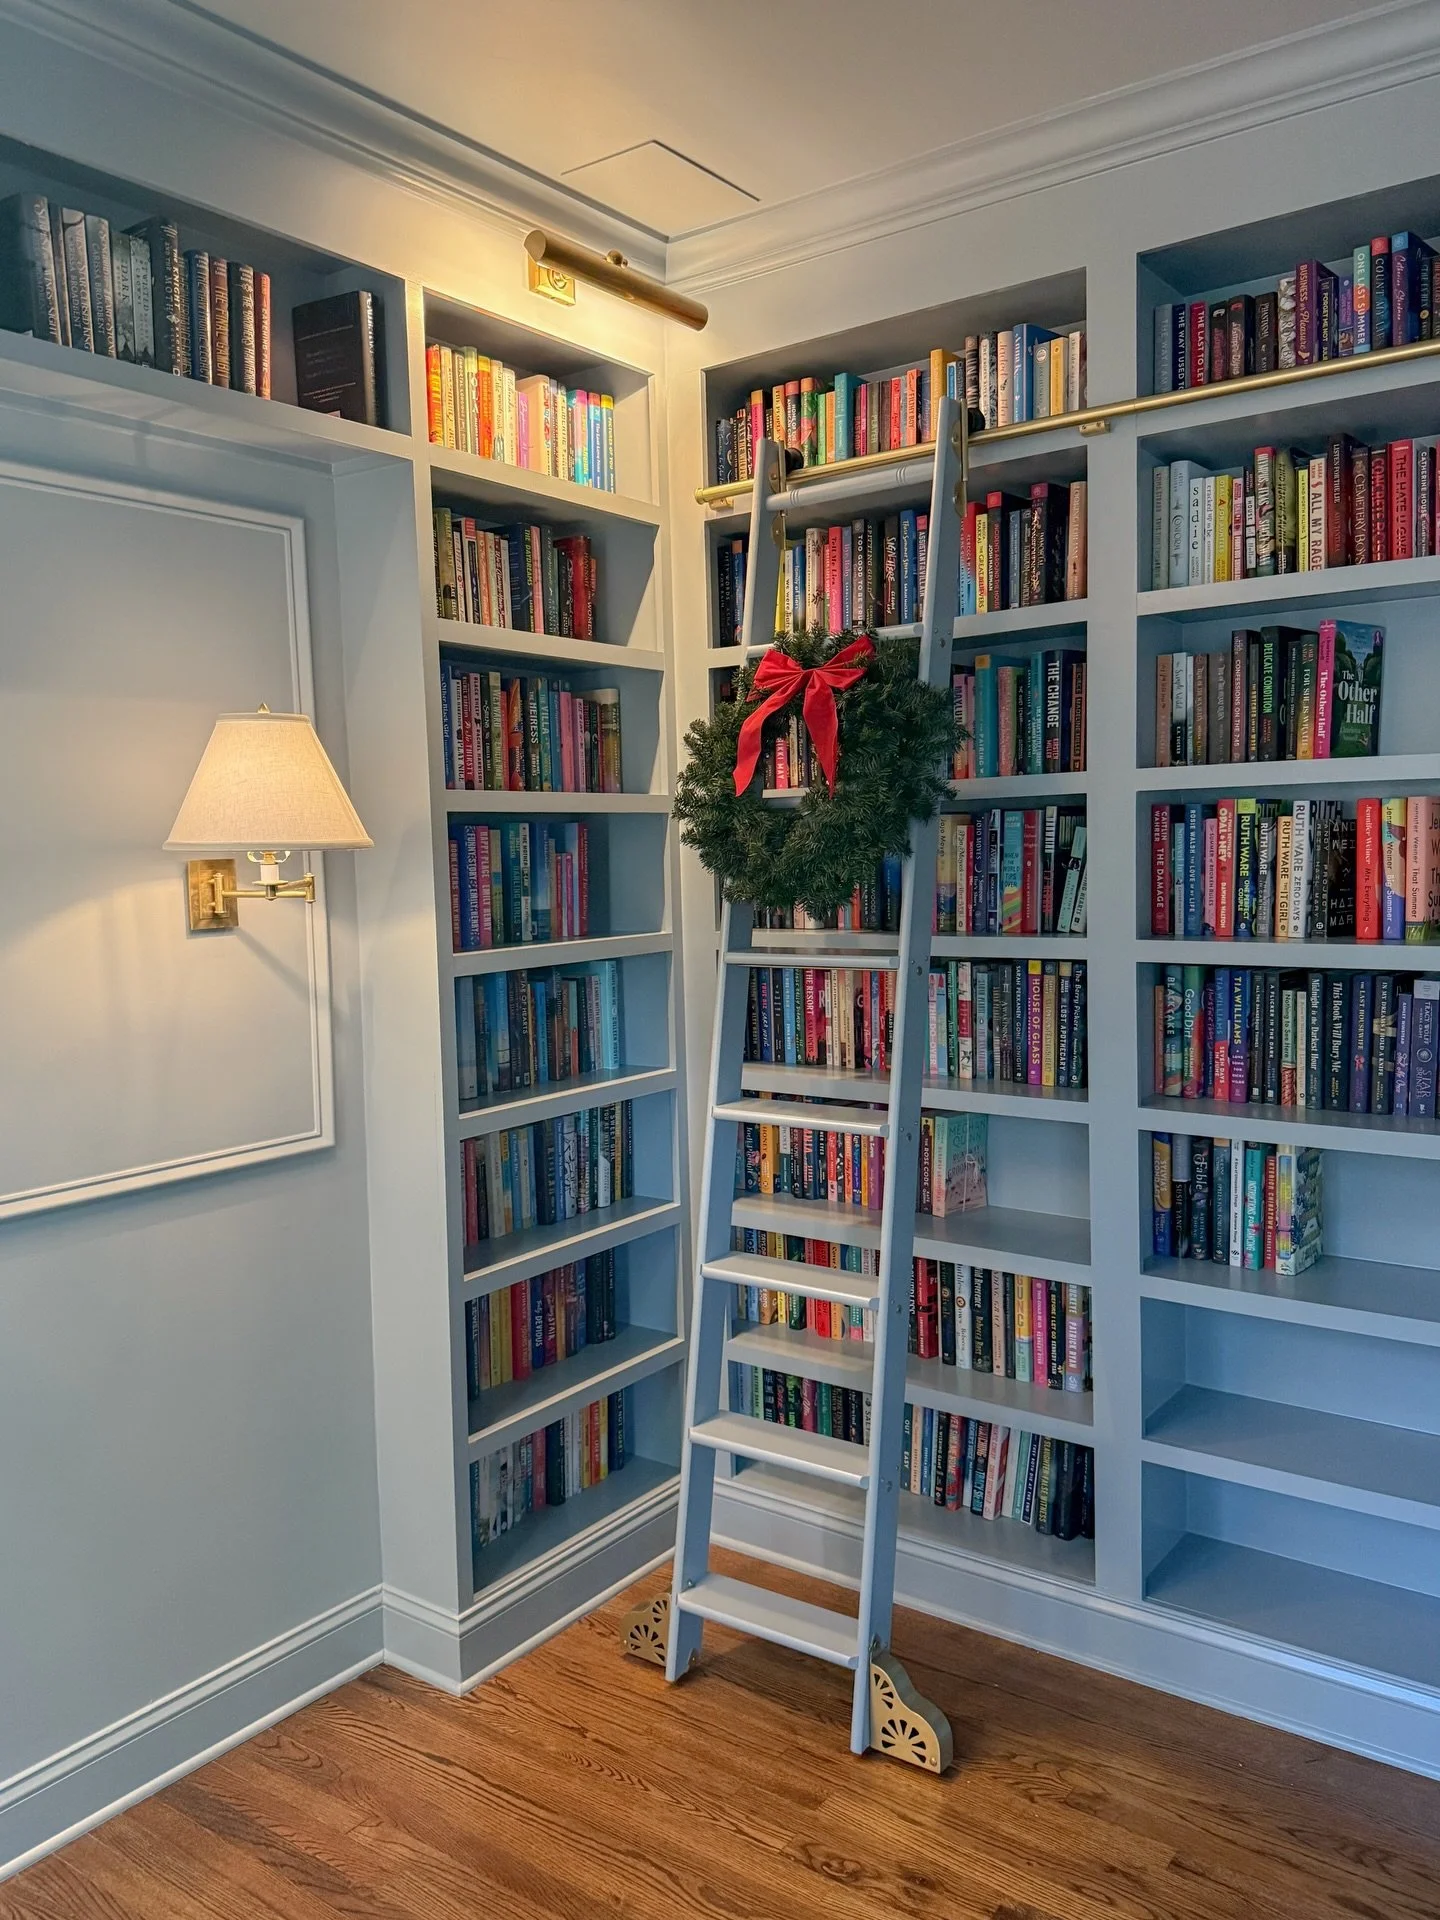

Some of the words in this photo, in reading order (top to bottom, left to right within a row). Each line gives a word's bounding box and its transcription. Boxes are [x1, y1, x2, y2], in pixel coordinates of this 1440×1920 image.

[92, 243, 101, 278] CARISSA
[1357, 252, 1365, 273] ONE
[121, 265, 130, 301] DARK
[164, 275, 173, 312] MOTH
[215, 285, 228, 303] THE
[1357, 277, 1365, 301] LAST
[70, 275, 81, 328] BROADBENT
[94, 281, 105, 335] BROADBENT
[215, 309, 229, 338] FINAL
[1197, 310, 1205, 330] THE
[1357, 302, 1365, 345] SUMMER
[1197, 330, 1205, 352] LAST
[216, 342, 230, 378] GAMBIT
[1197, 353, 1204, 366] TO
[1396, 455, 1407, 479] THE
[1311, 492, 1322, 513] ALL
[1354, 474, 1366, 532] CEMETERY
[1396, 481, 1407, 512] HATE
[1191, 485, 1201, 551] sadie
[1311, 518, 1322, 535] MY
[1396, 514, 1407, 523] U
[1354, 533, 1366, 564] BOYS
[1396, 526, 1407, 555] GIVE
[831, 554, 838, 568] Me
[1311, 539, 1322, 571] RAGE
[857, 580, 864, 592] TO
[857, 592, 863, 603] BE
[1047, 660, 1060, 681] THE
[1263, 643, 1274, 674] DELICATE
[1319, 670, 1328, 687] The
[1342, 669, 1355, 681] The
[1262, 676, 1273, 714] CONDITION
[1318, 688, 1328, 717] Other
[1338, 680, 1378, 703] Other
[1046, 684, 1060, 729] CHANGE
[1346, 700, 1377, 725] Half
[529, 702, 539, 744] HEIRESS
[540, 706, 549, 735] VILLA
[1317, 718, 1327, 738] Half
[465, 744, 474, 776] THIRSTY
[1240, 815, 1251, 848] RUTH
[1294, 804, 1306, 837] RUTH
[466, 833, 476, 856] FUNNY
[480, 831, 489, 855] HAPPY
[1259, 822, 1268, 848] RUTH
[1239, 849, 1249, 877] WARE
[1259, 849, 1268, 876] WARE
[1294, 839, 1303, 872] WARE
[468, 859, 477, 880] STORY
[481, 857, 490, 879] PLACE
[469, 888, 478, 908] EMILY
[482, 884, 490, 906] EMILY
[1156, 868, 1164, 908] DAMAGE
[1292, 901, 1300, 921] DAYS
[1363, 885, 1371, 922] Everything
[470, 910, 479, 932] HENRY
[483, 908, 492, 931] HENRY
[805, 969, 814, 984] THE
[1074, 970, 1083, 982] The
[1234, 976, 1242, 993] TIA
[520, 993, 527, 1005] OF
[806, 985, 814, 1017] RESORT
[1032, 978, 1040, 1013] HOUSE
[1073, 984, 1082, 1004] Berry
[1332, 981, 1343, 999] This
[1060, 1004, 1068, 1023] LOST
[1184, 988, 1195, 1018] Good
[1332, 999, 1343, 1020] Book
[1000, 1001, 1009, 1041] AWAKENING
[1032, 1016, 1040, 1030] OF
[1184, 1019, 1194, 1038] Dirt
[1234, 995, 1242, 1045] WILLIAMS
[1332, 1022, 1343, 1038] Will
[1032, 1032, 1041, 1065] GLASS
[1059, 1024, 1067, 1071] APOTHECARY
[1329, 1040, 1342, 1059] Bury
[1331, 1060, 1342, 1073] Me
[1421, 1070, 1432, 1098] STAR
[1194, 1160, 1208, 1190] Fable
[535, 1315, 543, 1347] DEVIOUS
[1068, 1320, 1078, 1350] PATRICK
[1068, 1351, 1078, 1369] RYAN
[1039, 1476, 1049, 1497] FALSE
[1039, 1497, 1048, 1523] WITNESS
